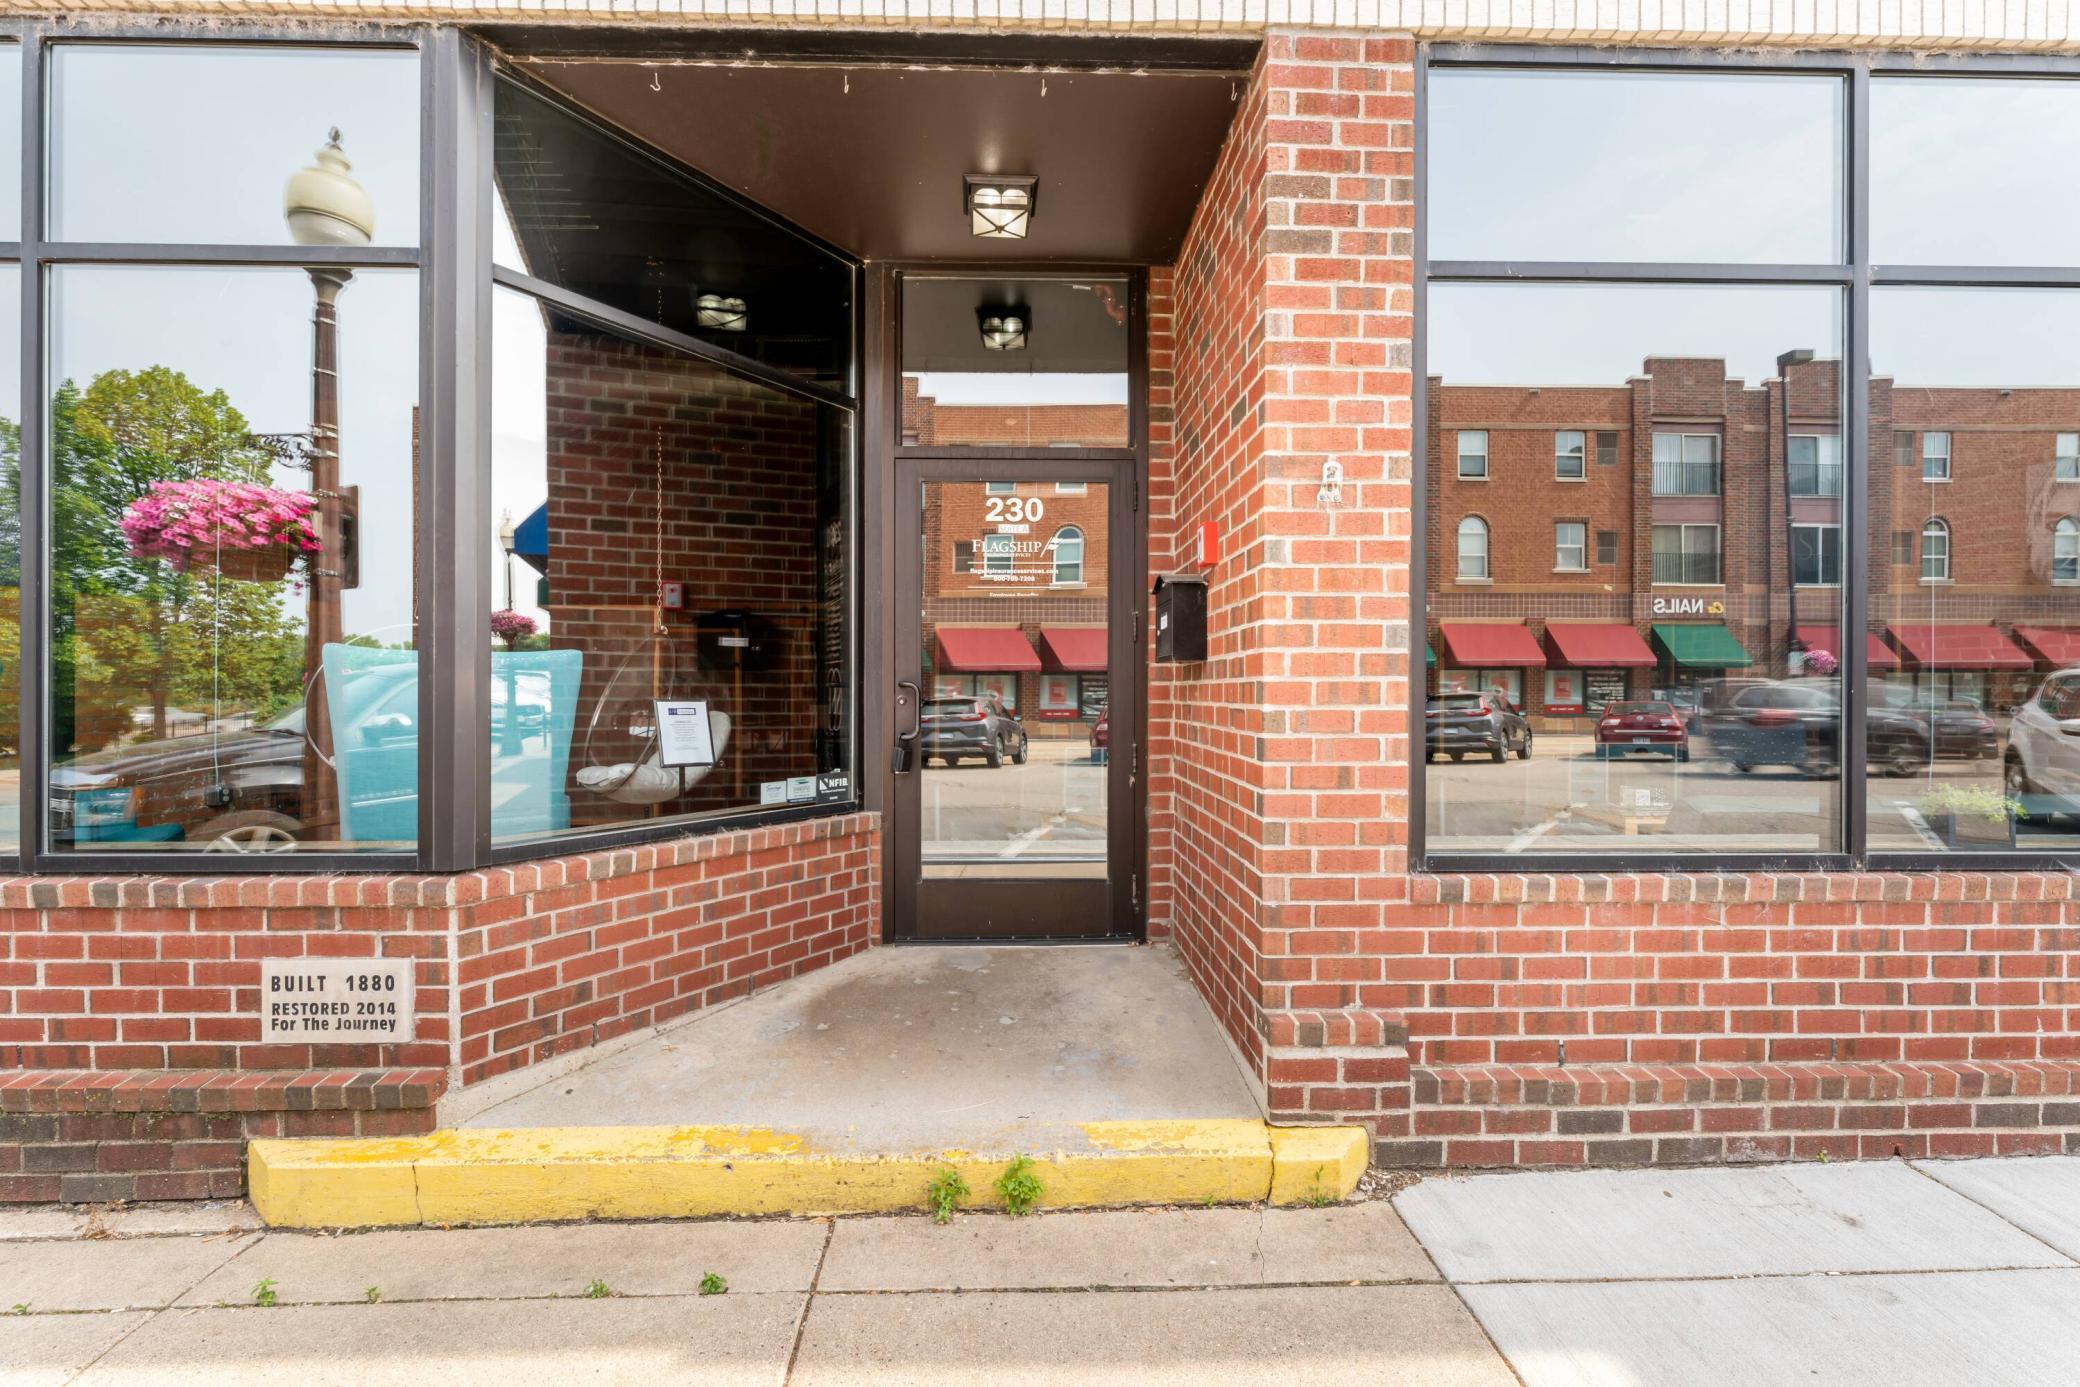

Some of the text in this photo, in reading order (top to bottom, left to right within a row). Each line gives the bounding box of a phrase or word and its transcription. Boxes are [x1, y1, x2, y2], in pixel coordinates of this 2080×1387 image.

[985, 497, 1044, 522] 230
[971, 538, 1042, 553] FLAGSHIP
[271, 974, 395, 992] BUILT 1880
[272, 1002, 396, 1015] RESTORED 2014
[272, 1017, 396, 1033] For The Journey
